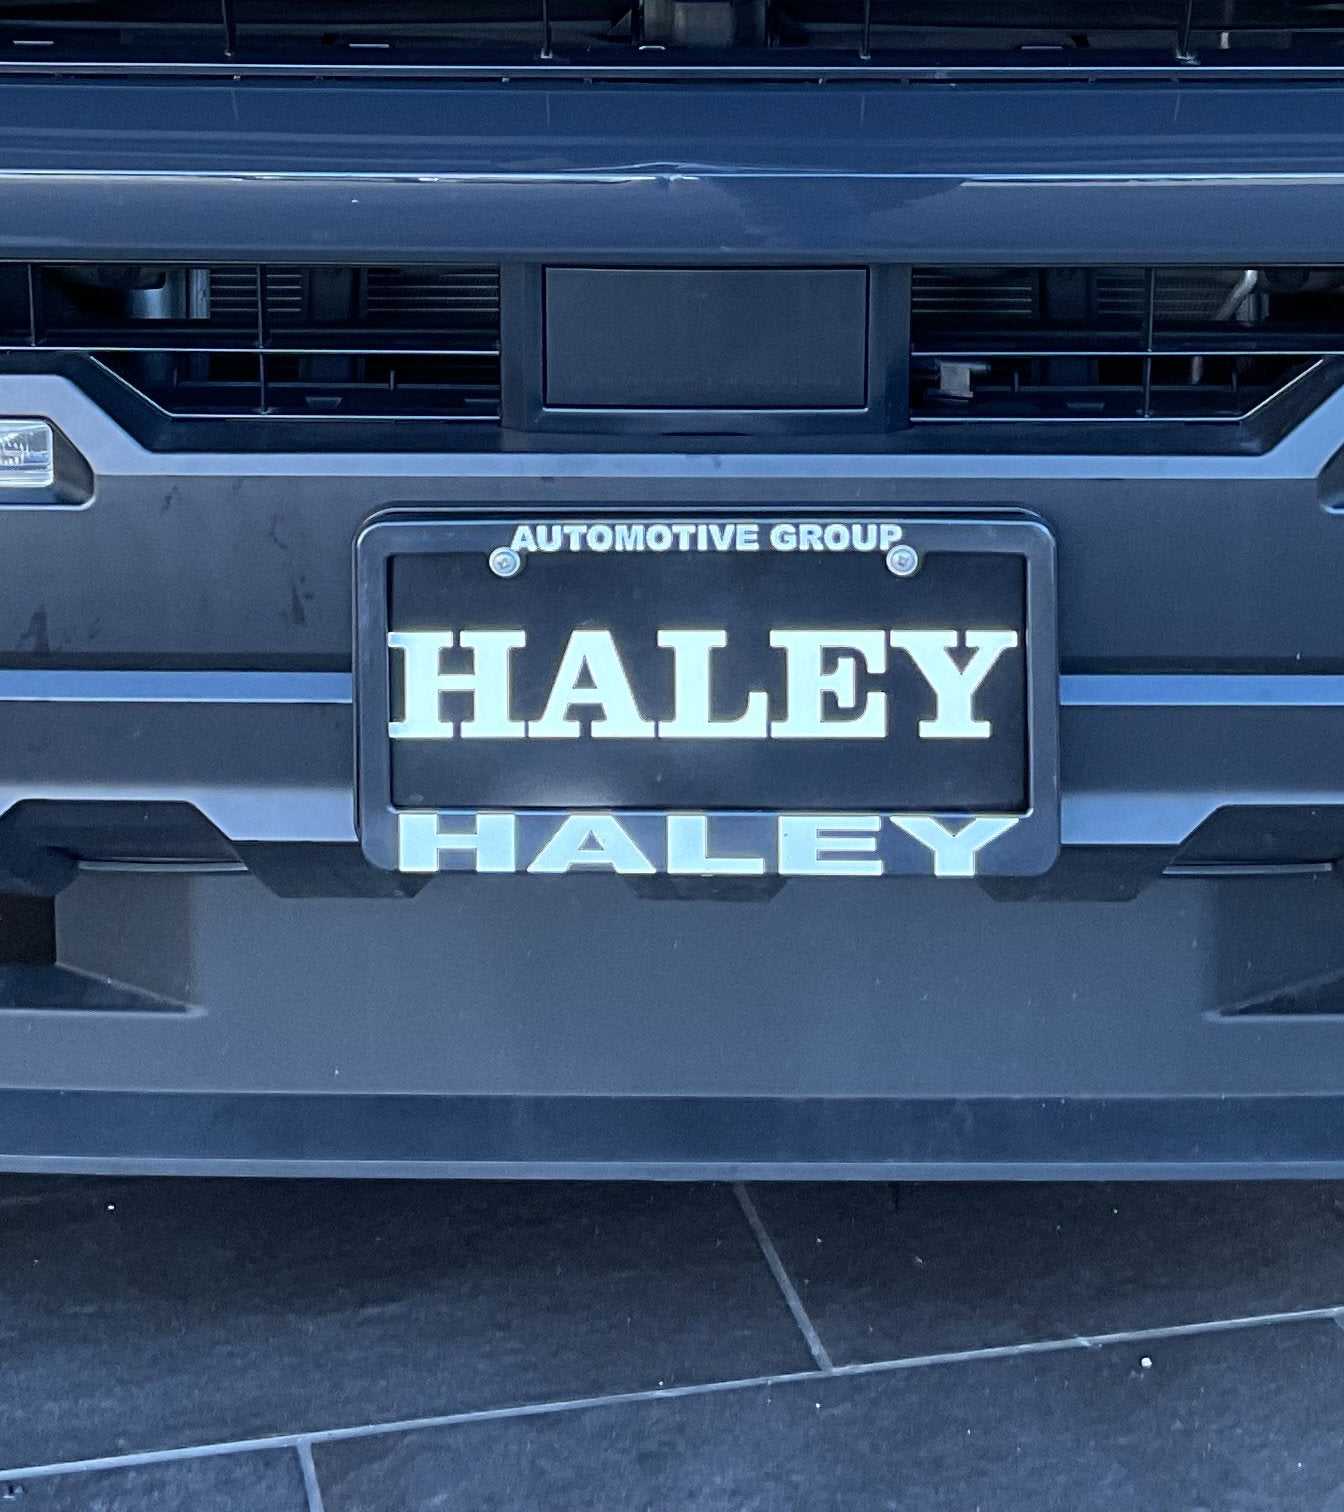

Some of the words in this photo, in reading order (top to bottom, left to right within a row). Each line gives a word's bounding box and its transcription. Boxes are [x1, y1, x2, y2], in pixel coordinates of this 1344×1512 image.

[510, 523, 760, 552] AUTOMOTIVE
[776, 524, 904, 552] GROUP
[387, 628, 1019, 739] HALEY
[397, 813, 1021, 877] HALEY
